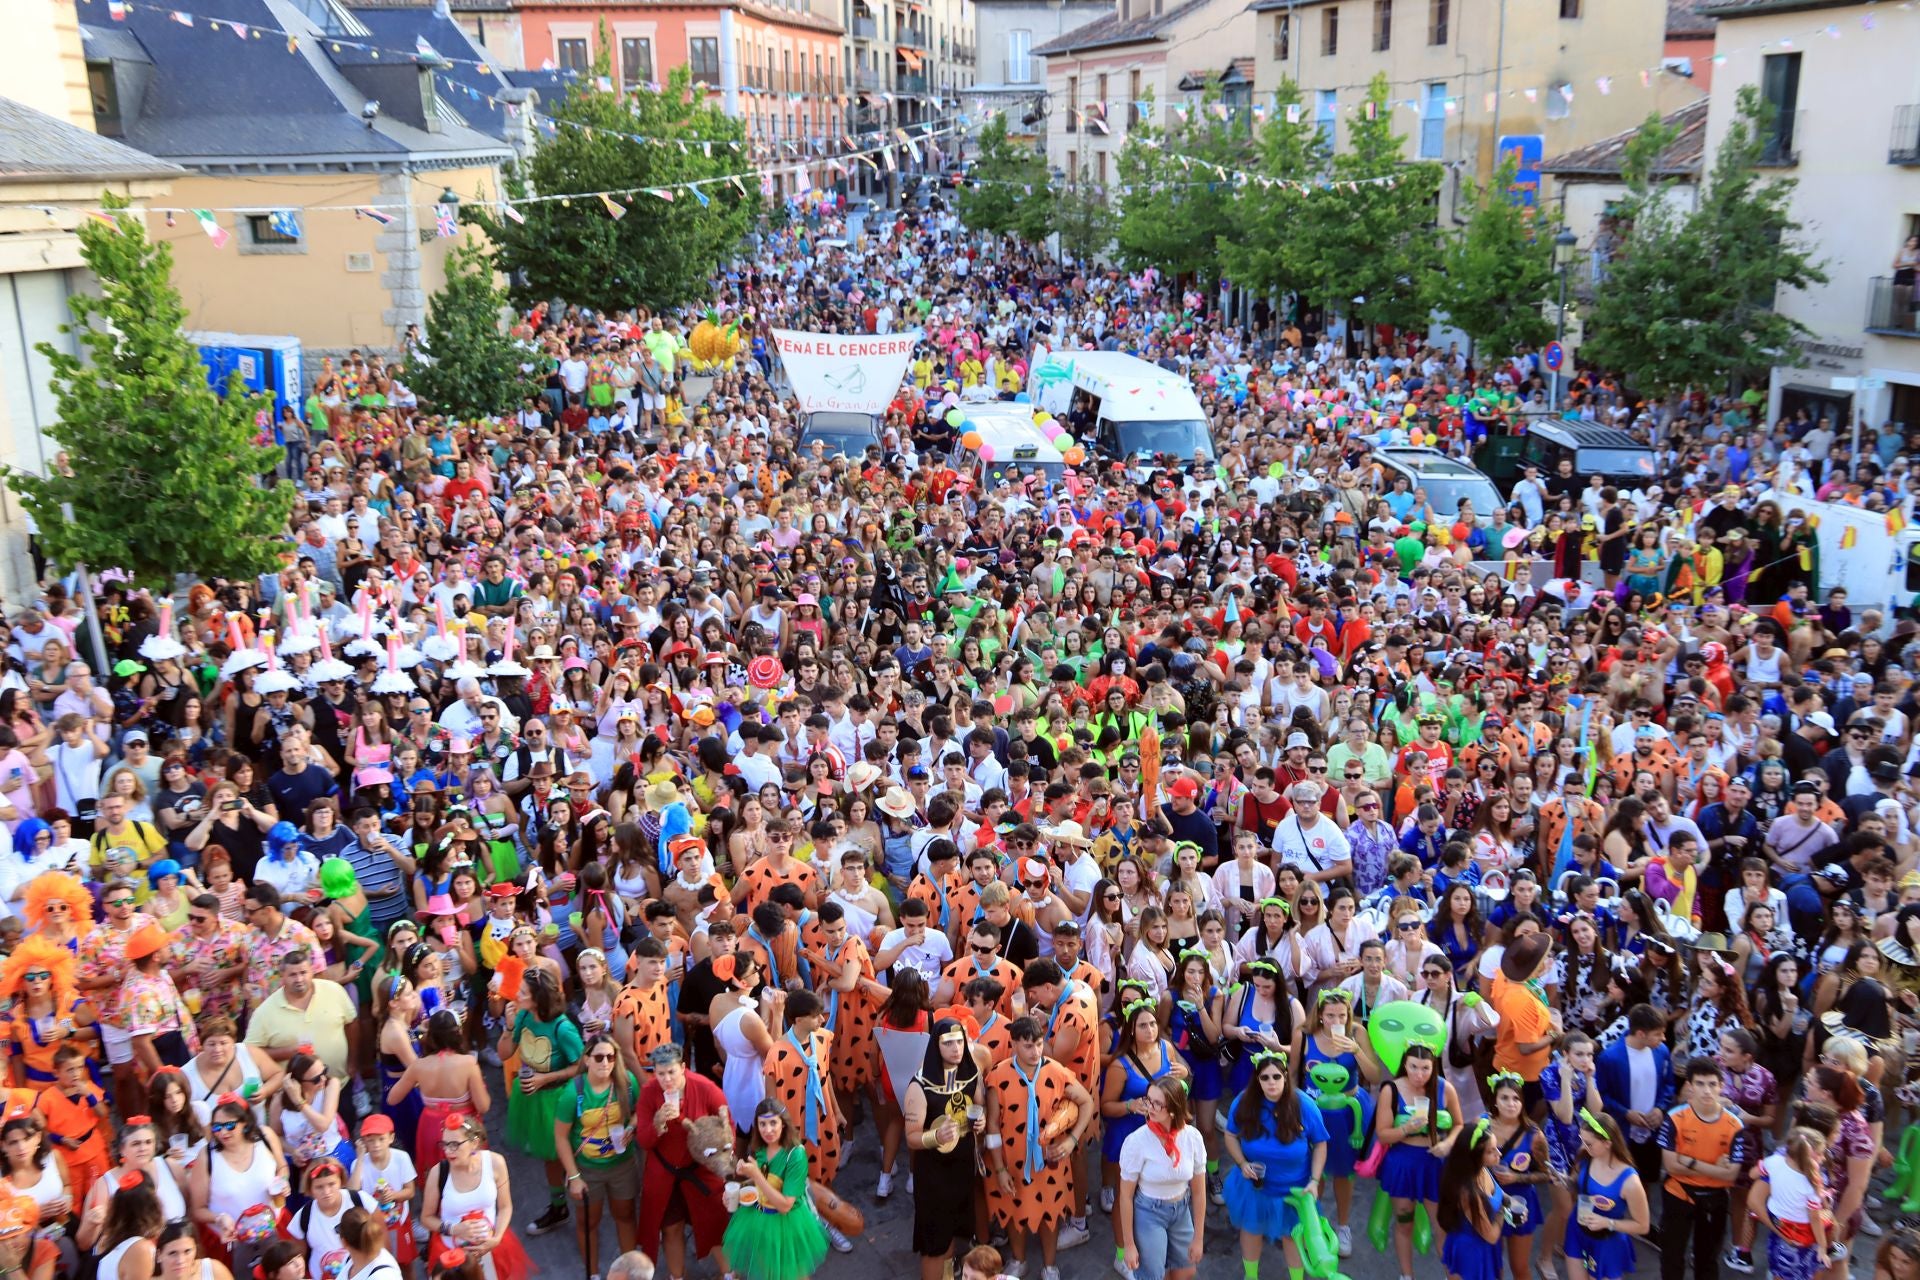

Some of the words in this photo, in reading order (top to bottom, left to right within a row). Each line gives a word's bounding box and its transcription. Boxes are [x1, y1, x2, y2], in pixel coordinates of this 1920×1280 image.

[816, 343, 835, 356] EL
[806, 395, 824, 409] La
[827, 396, 878, 411] Granja
